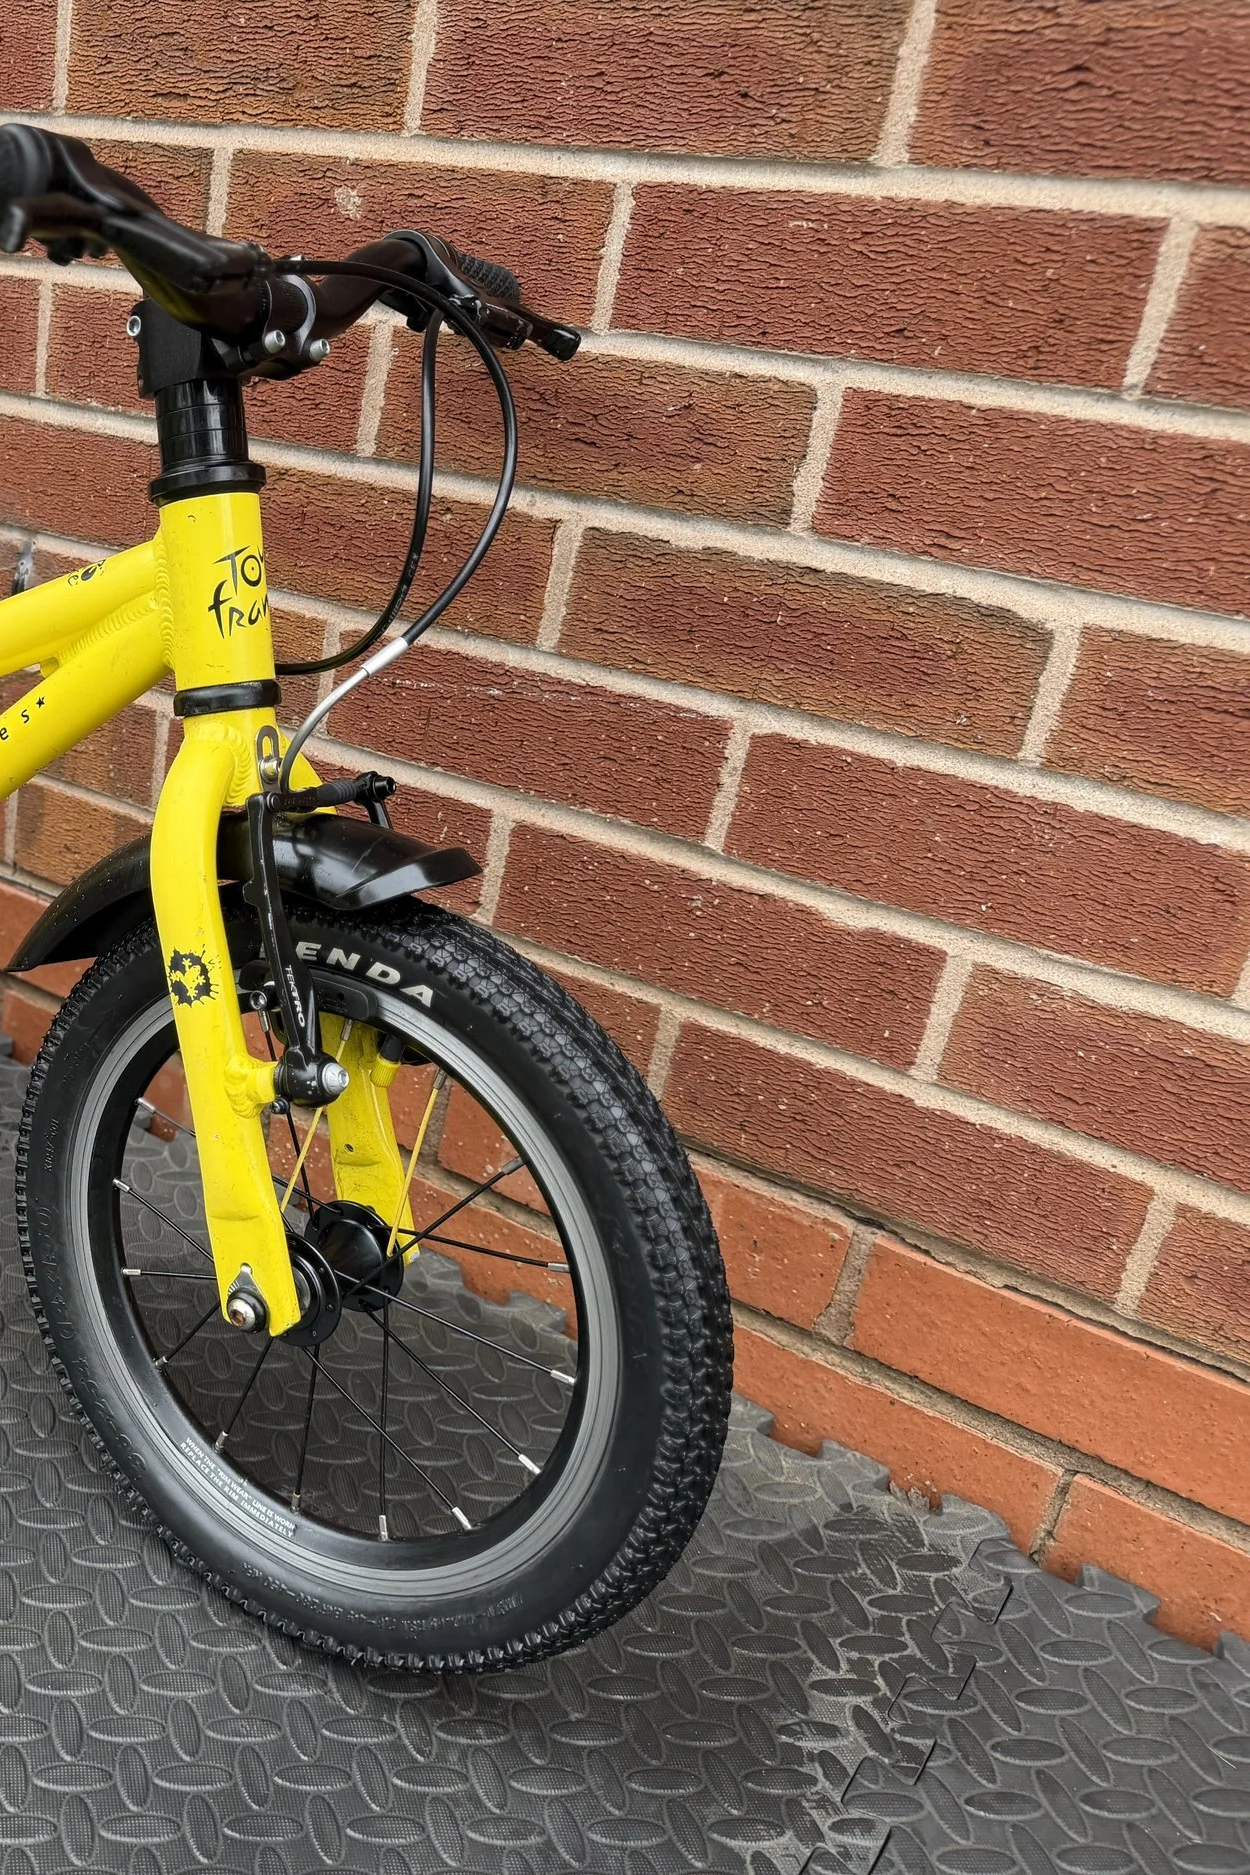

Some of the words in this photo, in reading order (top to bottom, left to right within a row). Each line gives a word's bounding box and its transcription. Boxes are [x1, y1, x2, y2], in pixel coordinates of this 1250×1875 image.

[260, 941, 434, 1008] ENDA
[285, 964, 306, 1028] TEKTRO
[180, 1442, 210, 1475] REPLACE
[209, 1472, 223, 1487] THE
[223, 1485, 239, 1502] RIM
[240, 1500, 294, 1538] IMMEDIATELY
[185, 1437, 204, 1458] WHEN
[204, 1454, 217, 1470] THE
[252, 1499, 267, 1513] LINE
[273, 1514, 296, 1530] WORN
